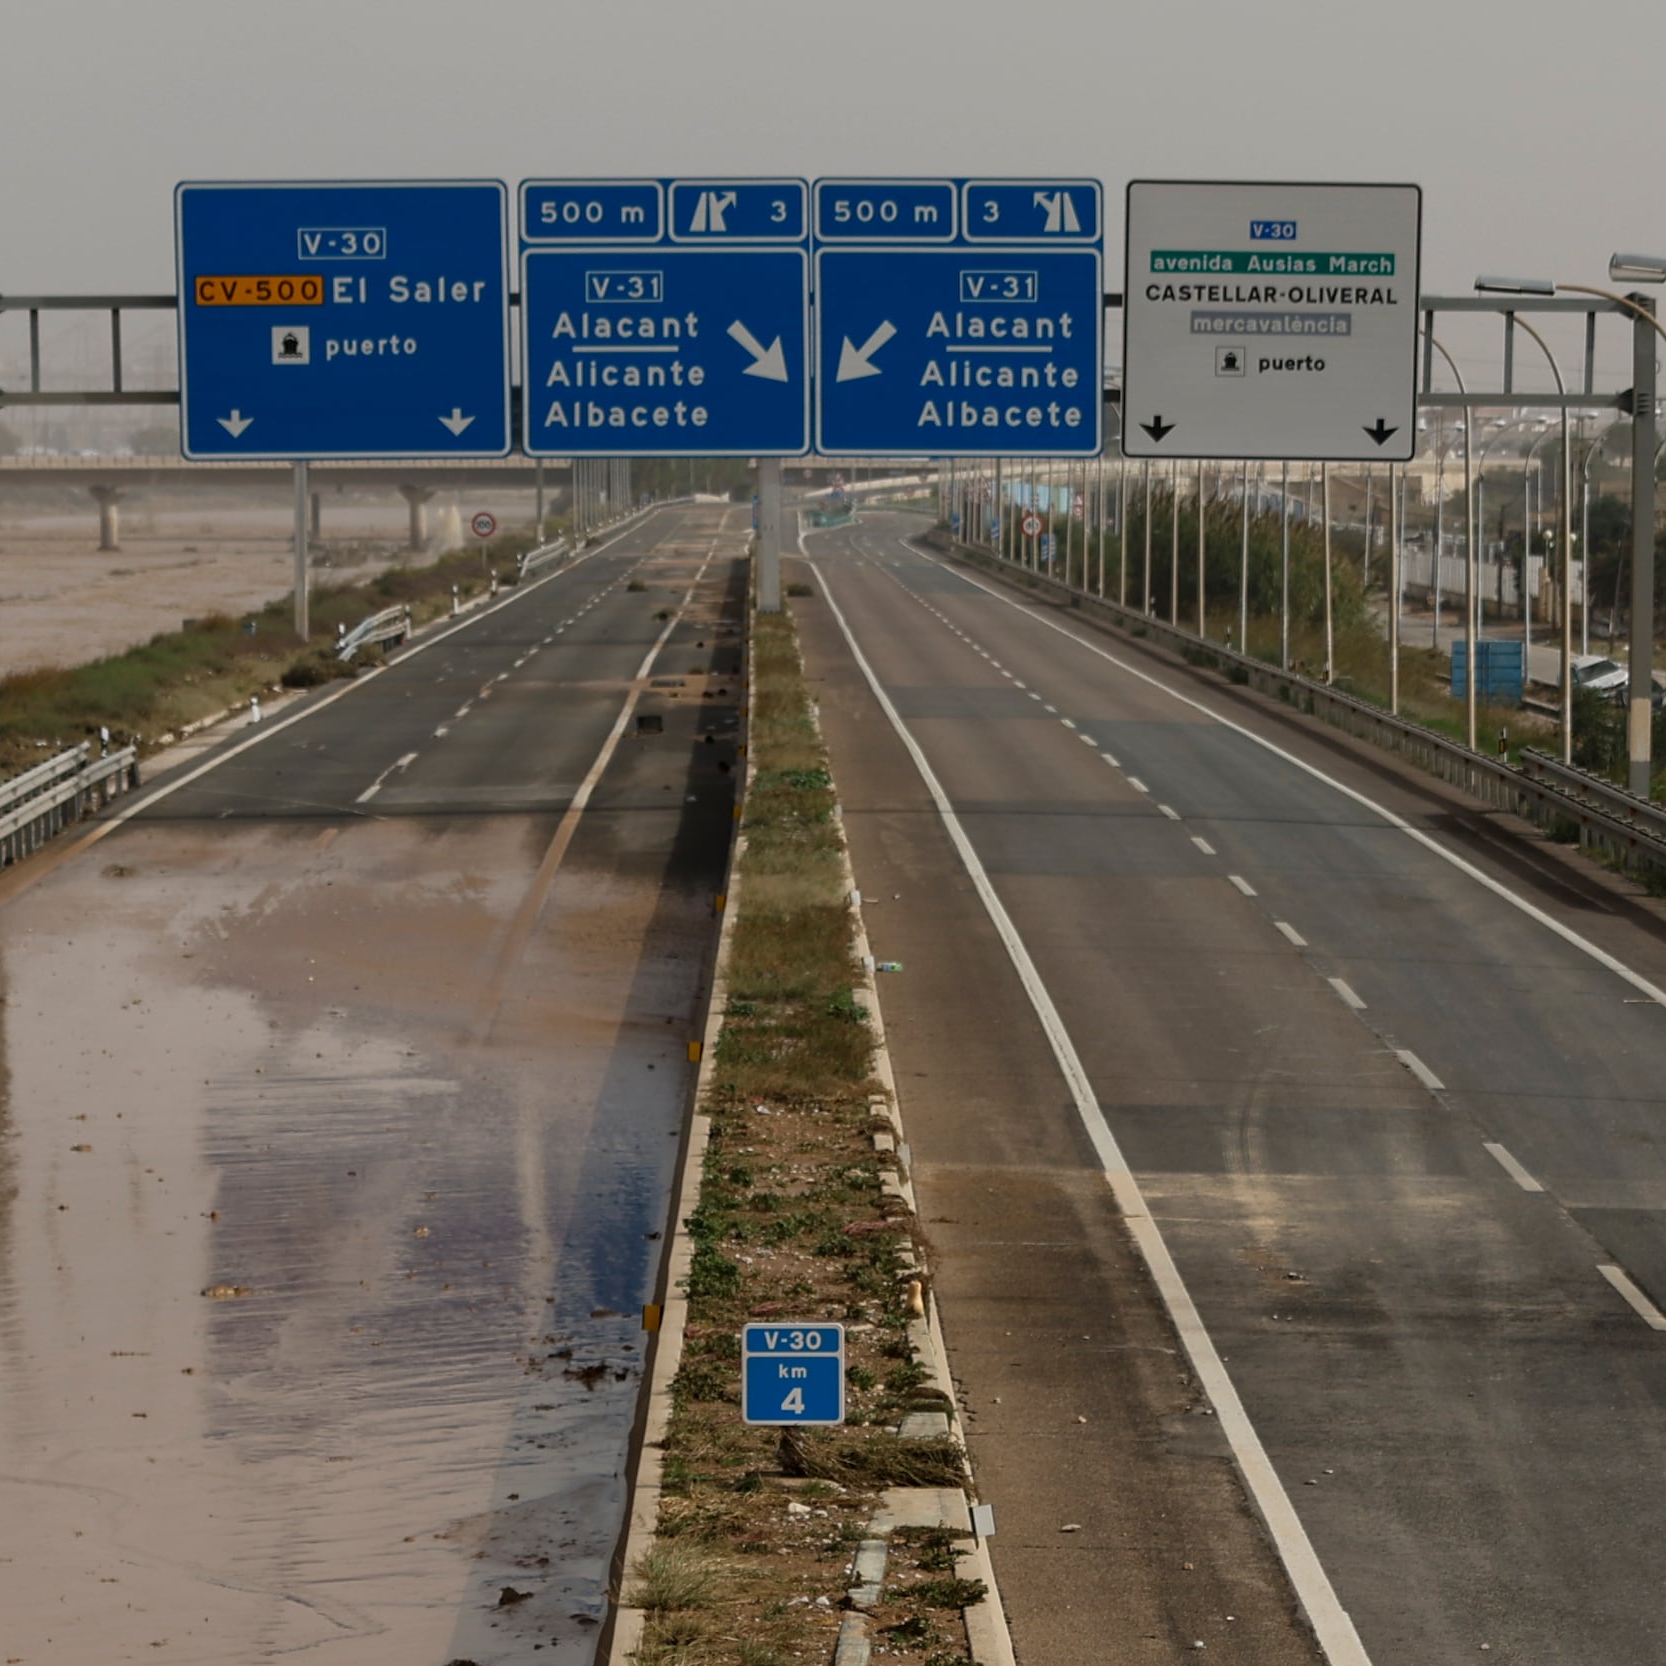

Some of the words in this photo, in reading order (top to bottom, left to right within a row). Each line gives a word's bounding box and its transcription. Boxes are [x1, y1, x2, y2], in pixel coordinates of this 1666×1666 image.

[541, 203, 602, 223] 500
[621, 206, 644, 223] m
[770, 202, 787, 222] 3
[834, 201, 897, 222] 500
[914, 206, 938, 222] m
[983, 202, 999, 223] 3
[1252, 223, 1294, 238] V-30
[303, 234, 380, 254] V-30
[1153, 255, 1232, 271] avenida
[1248, 255, 1316, 272] Ausias
[1329, 256, 1392, 273] March
[199, 280, 318, 302] CV-500
[333, 278, 365, 303] El
[390, 276, 485, 303] Saler
[592, 278, 659, 298] V-31
[967, 276, 1034, 298] V-31
[1145, 284, 1398, 305] CASTELLAR-OLIVERAL
[552, 312, 699, 338] Alacant
[926, 312, 1073, 338] Alacant
[326, 335, 417, 361] puerto
[547, 361, 705, 386] Alicante
[920, 362, 1079, 387] Alicante
[1258, 355, 1325, 373] puerto
[544, 402, 708, 427] Albacete
[918, 401, 1082, 427] Albacete
[764, 1331, 821, 1351] V-30
[779, 1364, 807, 1379] km
[781, 1387, 805, 1414] 4
